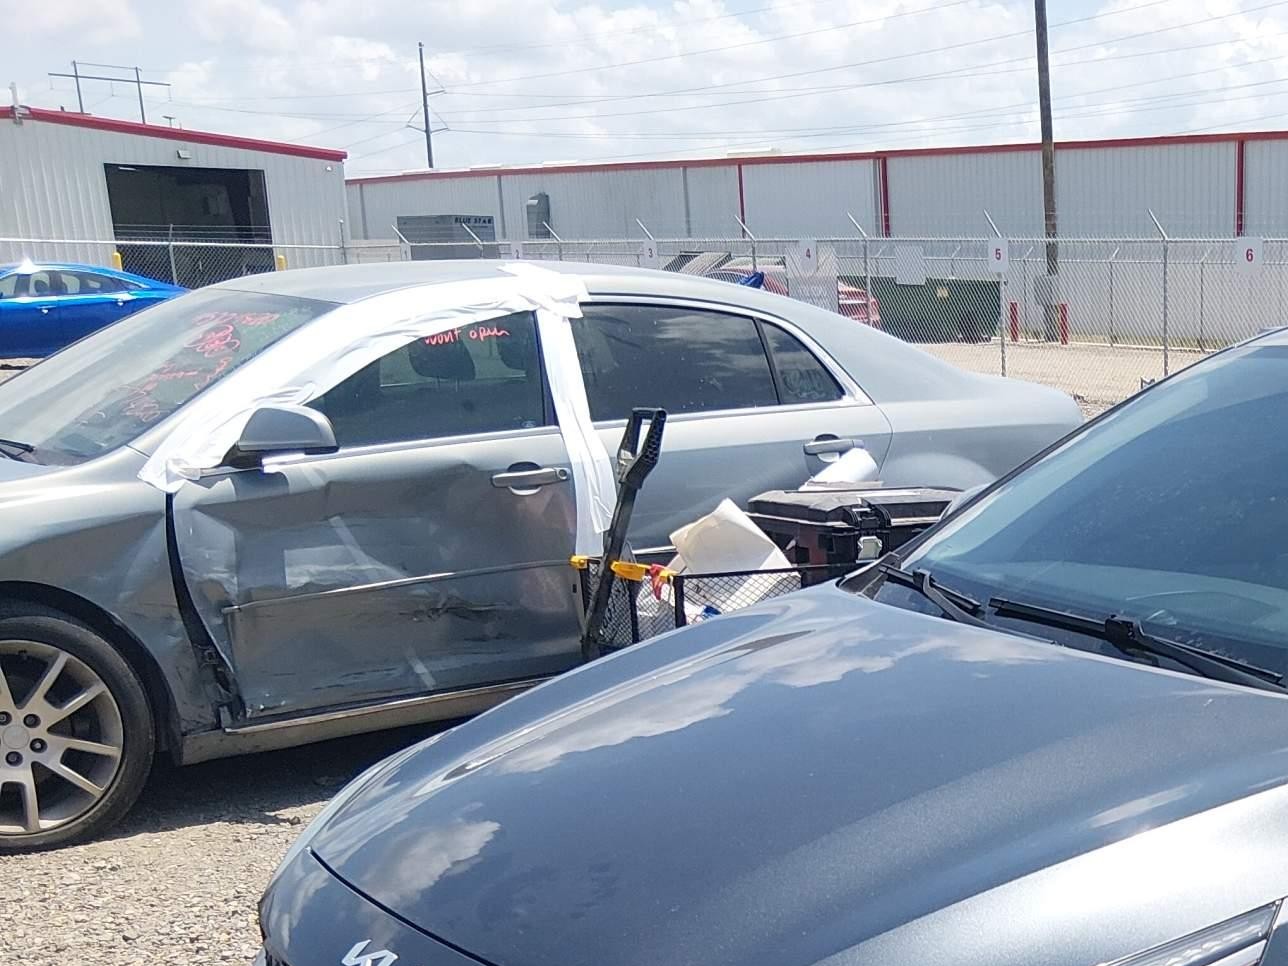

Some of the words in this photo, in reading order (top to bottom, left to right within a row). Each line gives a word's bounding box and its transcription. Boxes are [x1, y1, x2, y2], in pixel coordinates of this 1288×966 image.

[648, 248, 653, 257] 3
[805, 248, 811, 258] 4
[995, 248, 1002, 260] 5
[1246, 248, 1254, 262] 6
